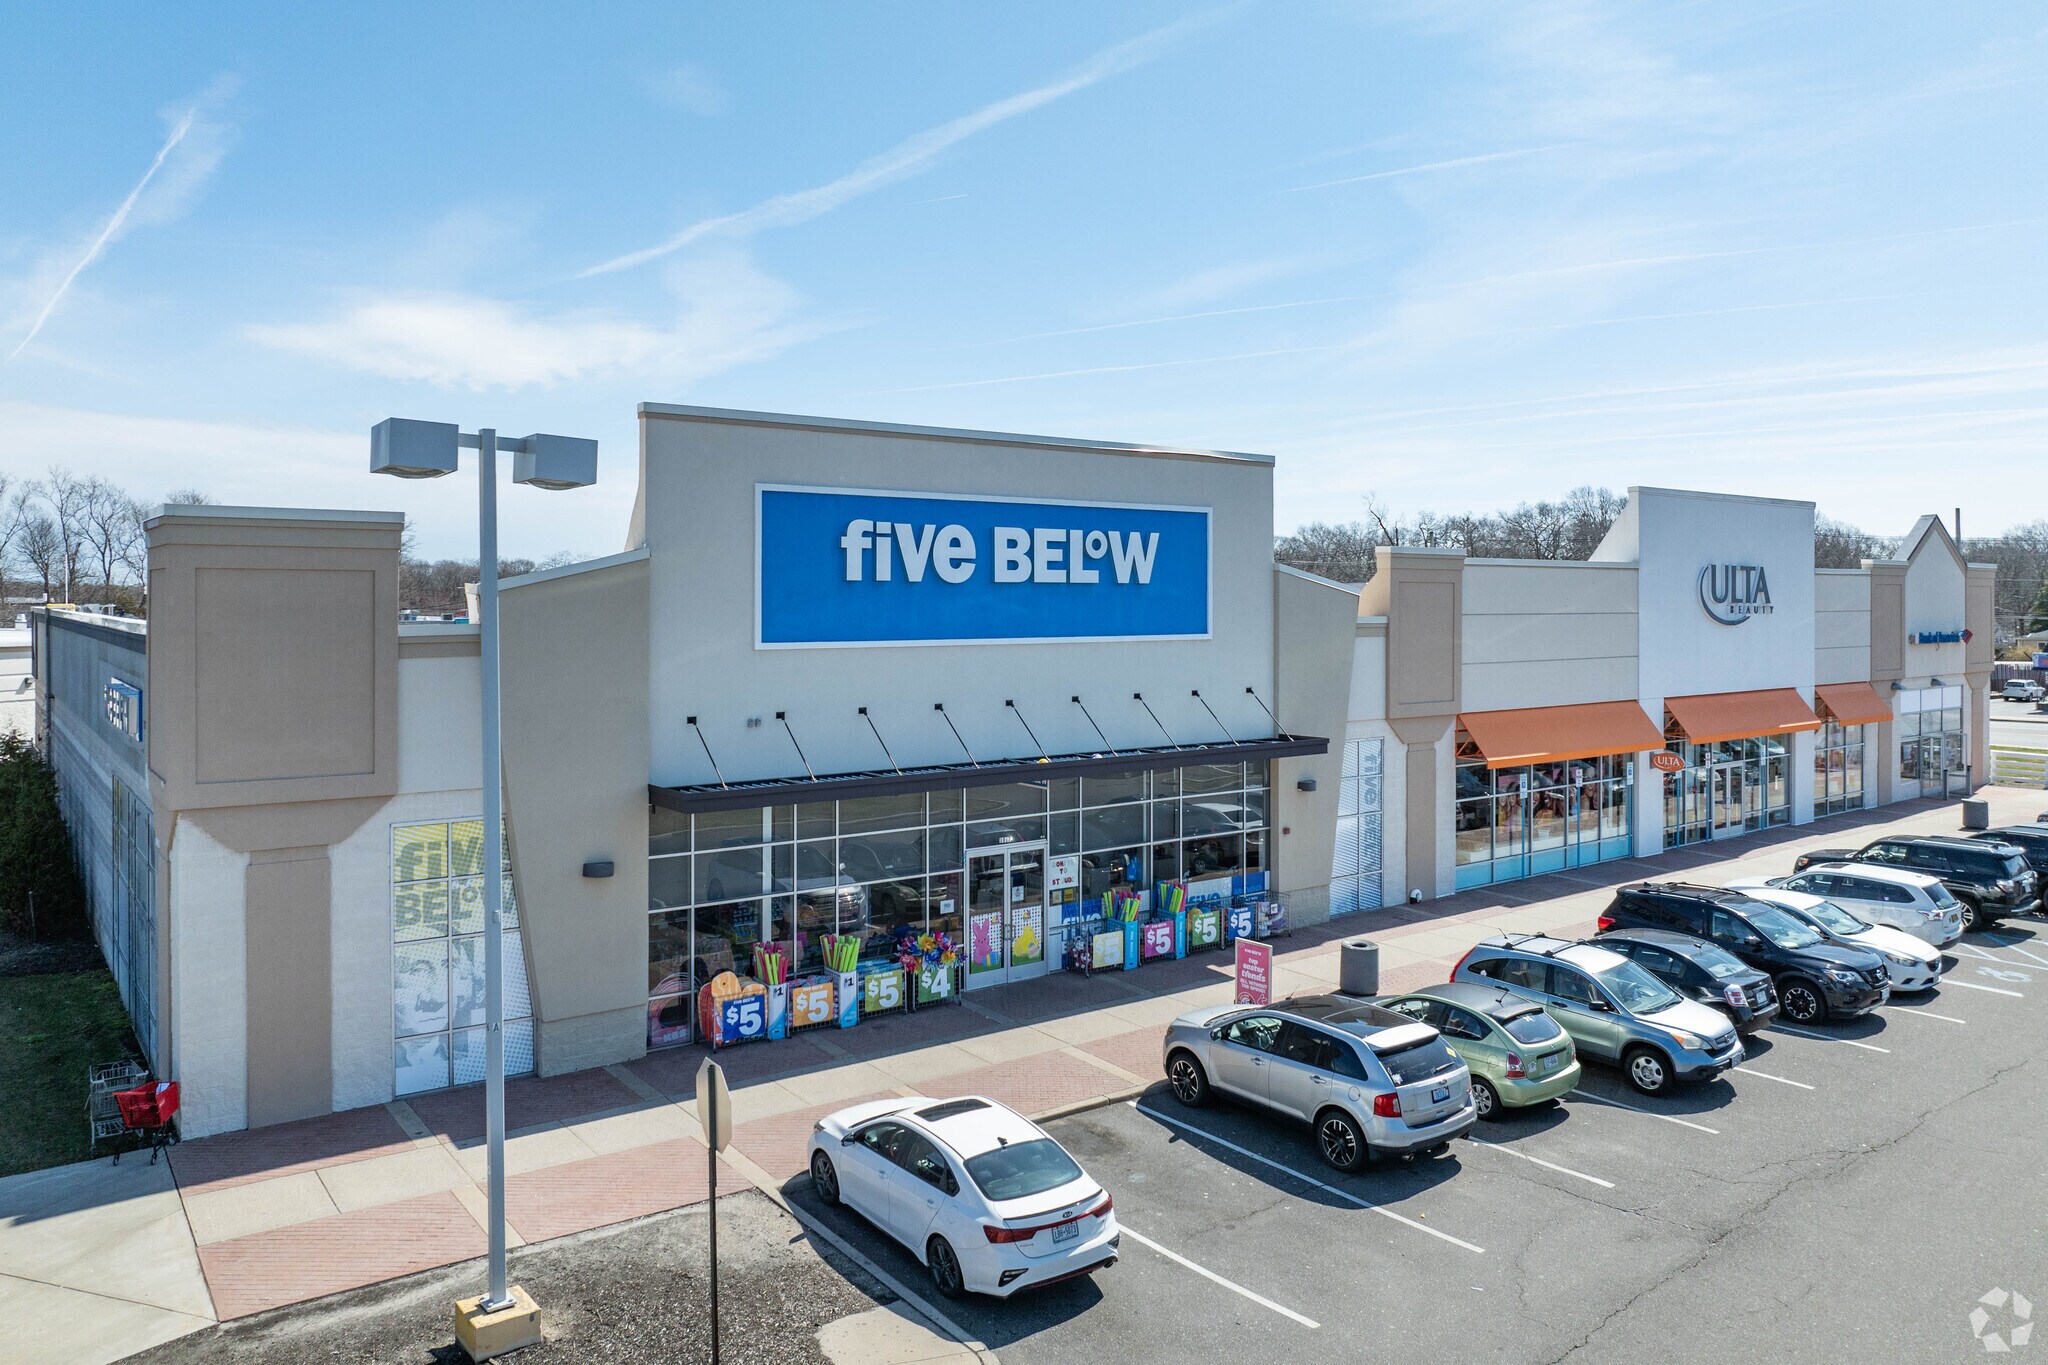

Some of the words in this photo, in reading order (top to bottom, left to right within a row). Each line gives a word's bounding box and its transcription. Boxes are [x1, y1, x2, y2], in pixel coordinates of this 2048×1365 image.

[841, 519, 976, 584] five
[1708, 564, 1771, 603] ULTA
[1728, 605, 1775, 614] BEAUTY
[1656, 755, 1681, 767] ULTA
[1194, 916, 1217, 943] $5
[1230, 911, 1252, 937] $5
[1095, 936, 1121, 964] $5
[1147, 926, 1171, 954] $5
[868, 976, 899, 1008] $5
[921, 967, 951, 998] $4
[726, 1001, 762, 1036] $5
[796, 989, 830, 1023] $5
